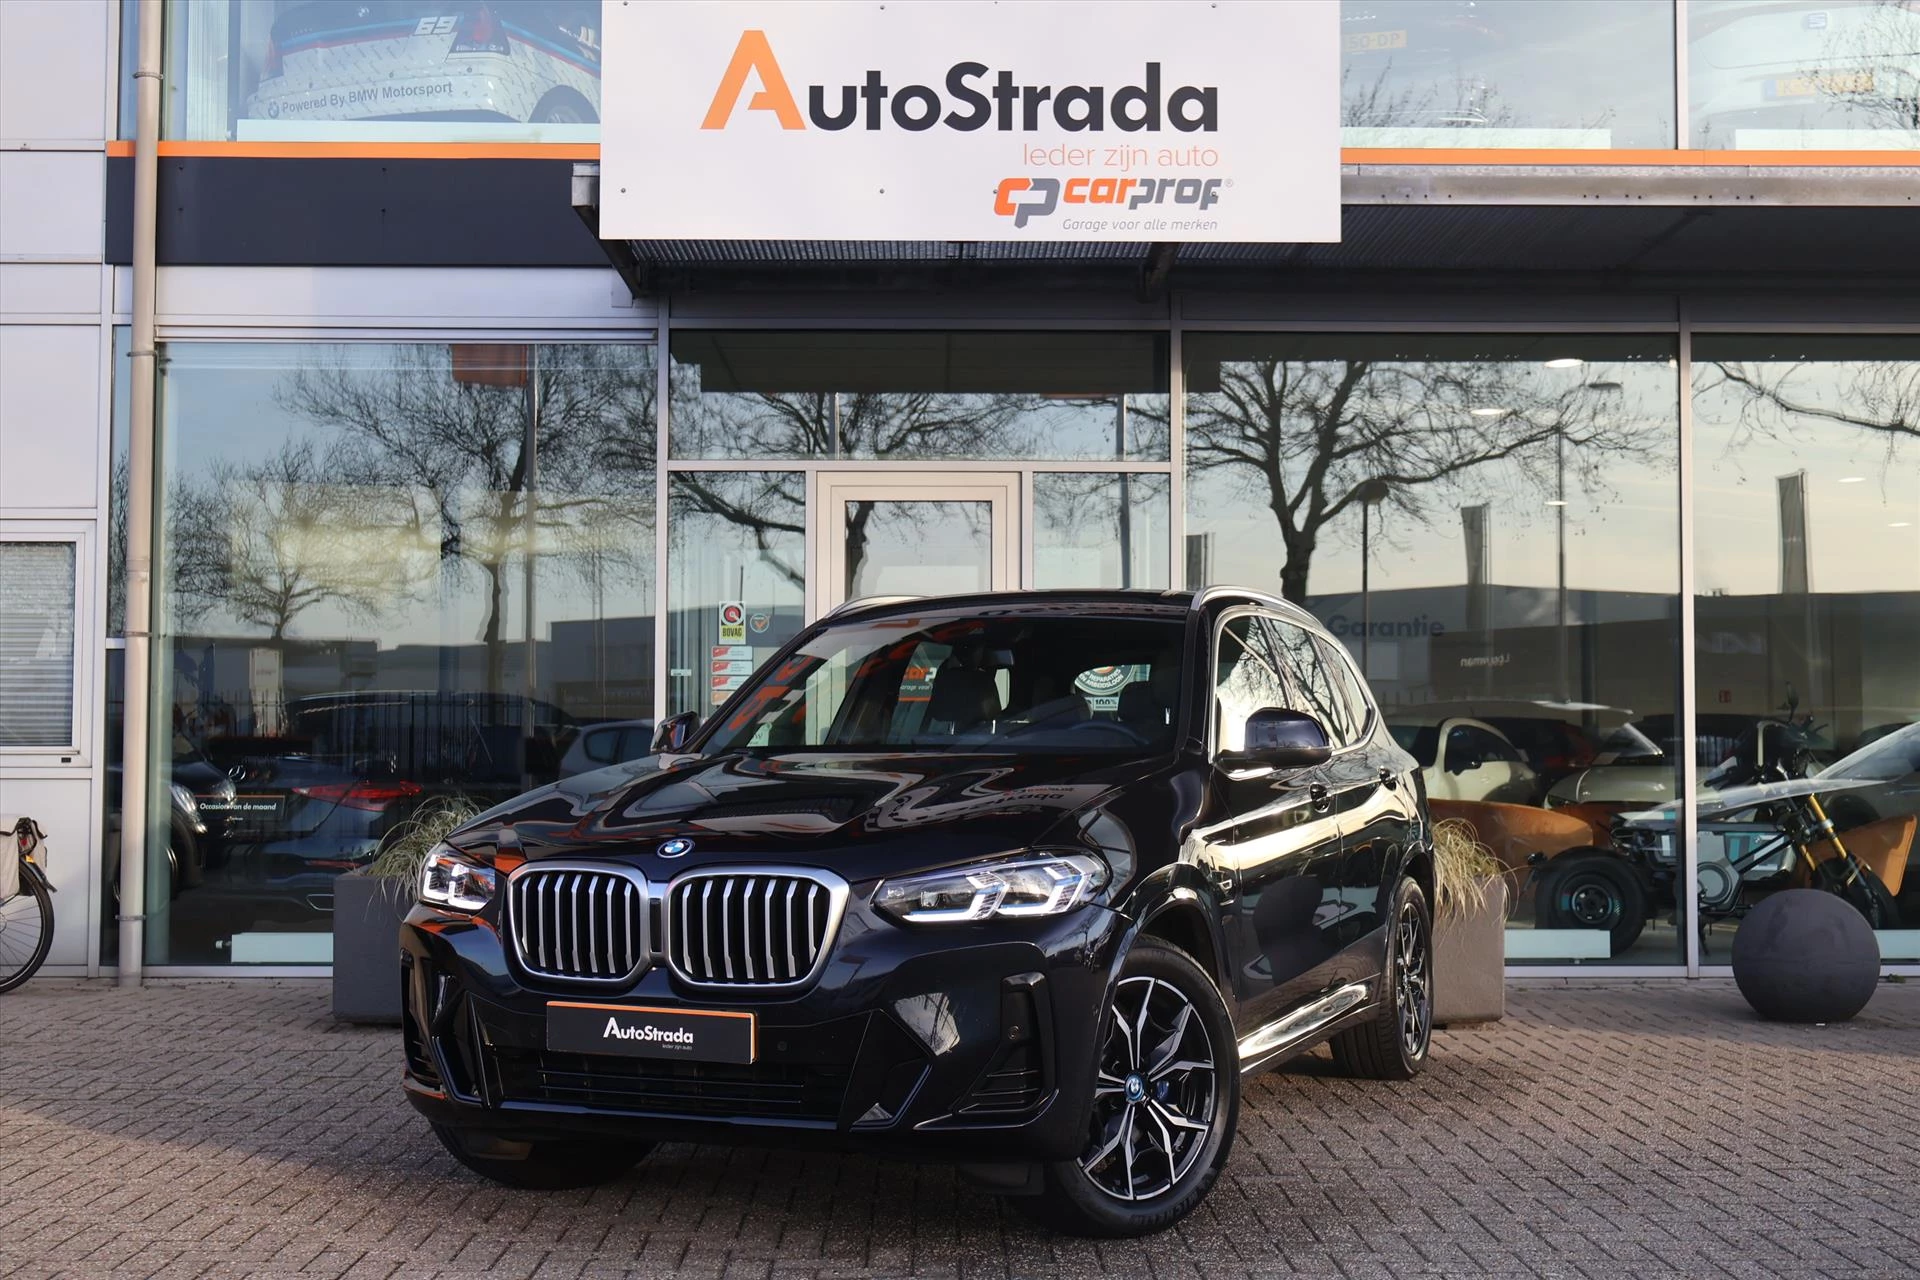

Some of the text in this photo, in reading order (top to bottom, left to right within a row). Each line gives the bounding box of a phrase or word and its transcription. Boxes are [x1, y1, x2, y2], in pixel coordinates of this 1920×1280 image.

[413, 15, 458, 36] 69
[700, 29, 1219, 132] AutoStrada
[282, 81, 453, 113] Powered By BMW Motorsport
[1023, 143, 1219, 172] Ieder zijn auto
[1063, 178, 1222, 211] carprof
[1062, 218, 1218, 232] Garage voor alle merken
[722, 627, 742, 638] BOVAG
[1327, 615, 1445, 637] Garantie
[243, 802, 252, 810] de
[252, 802, 277, 810] maand
[603, 1017, 693, 1044] AutoStrada
